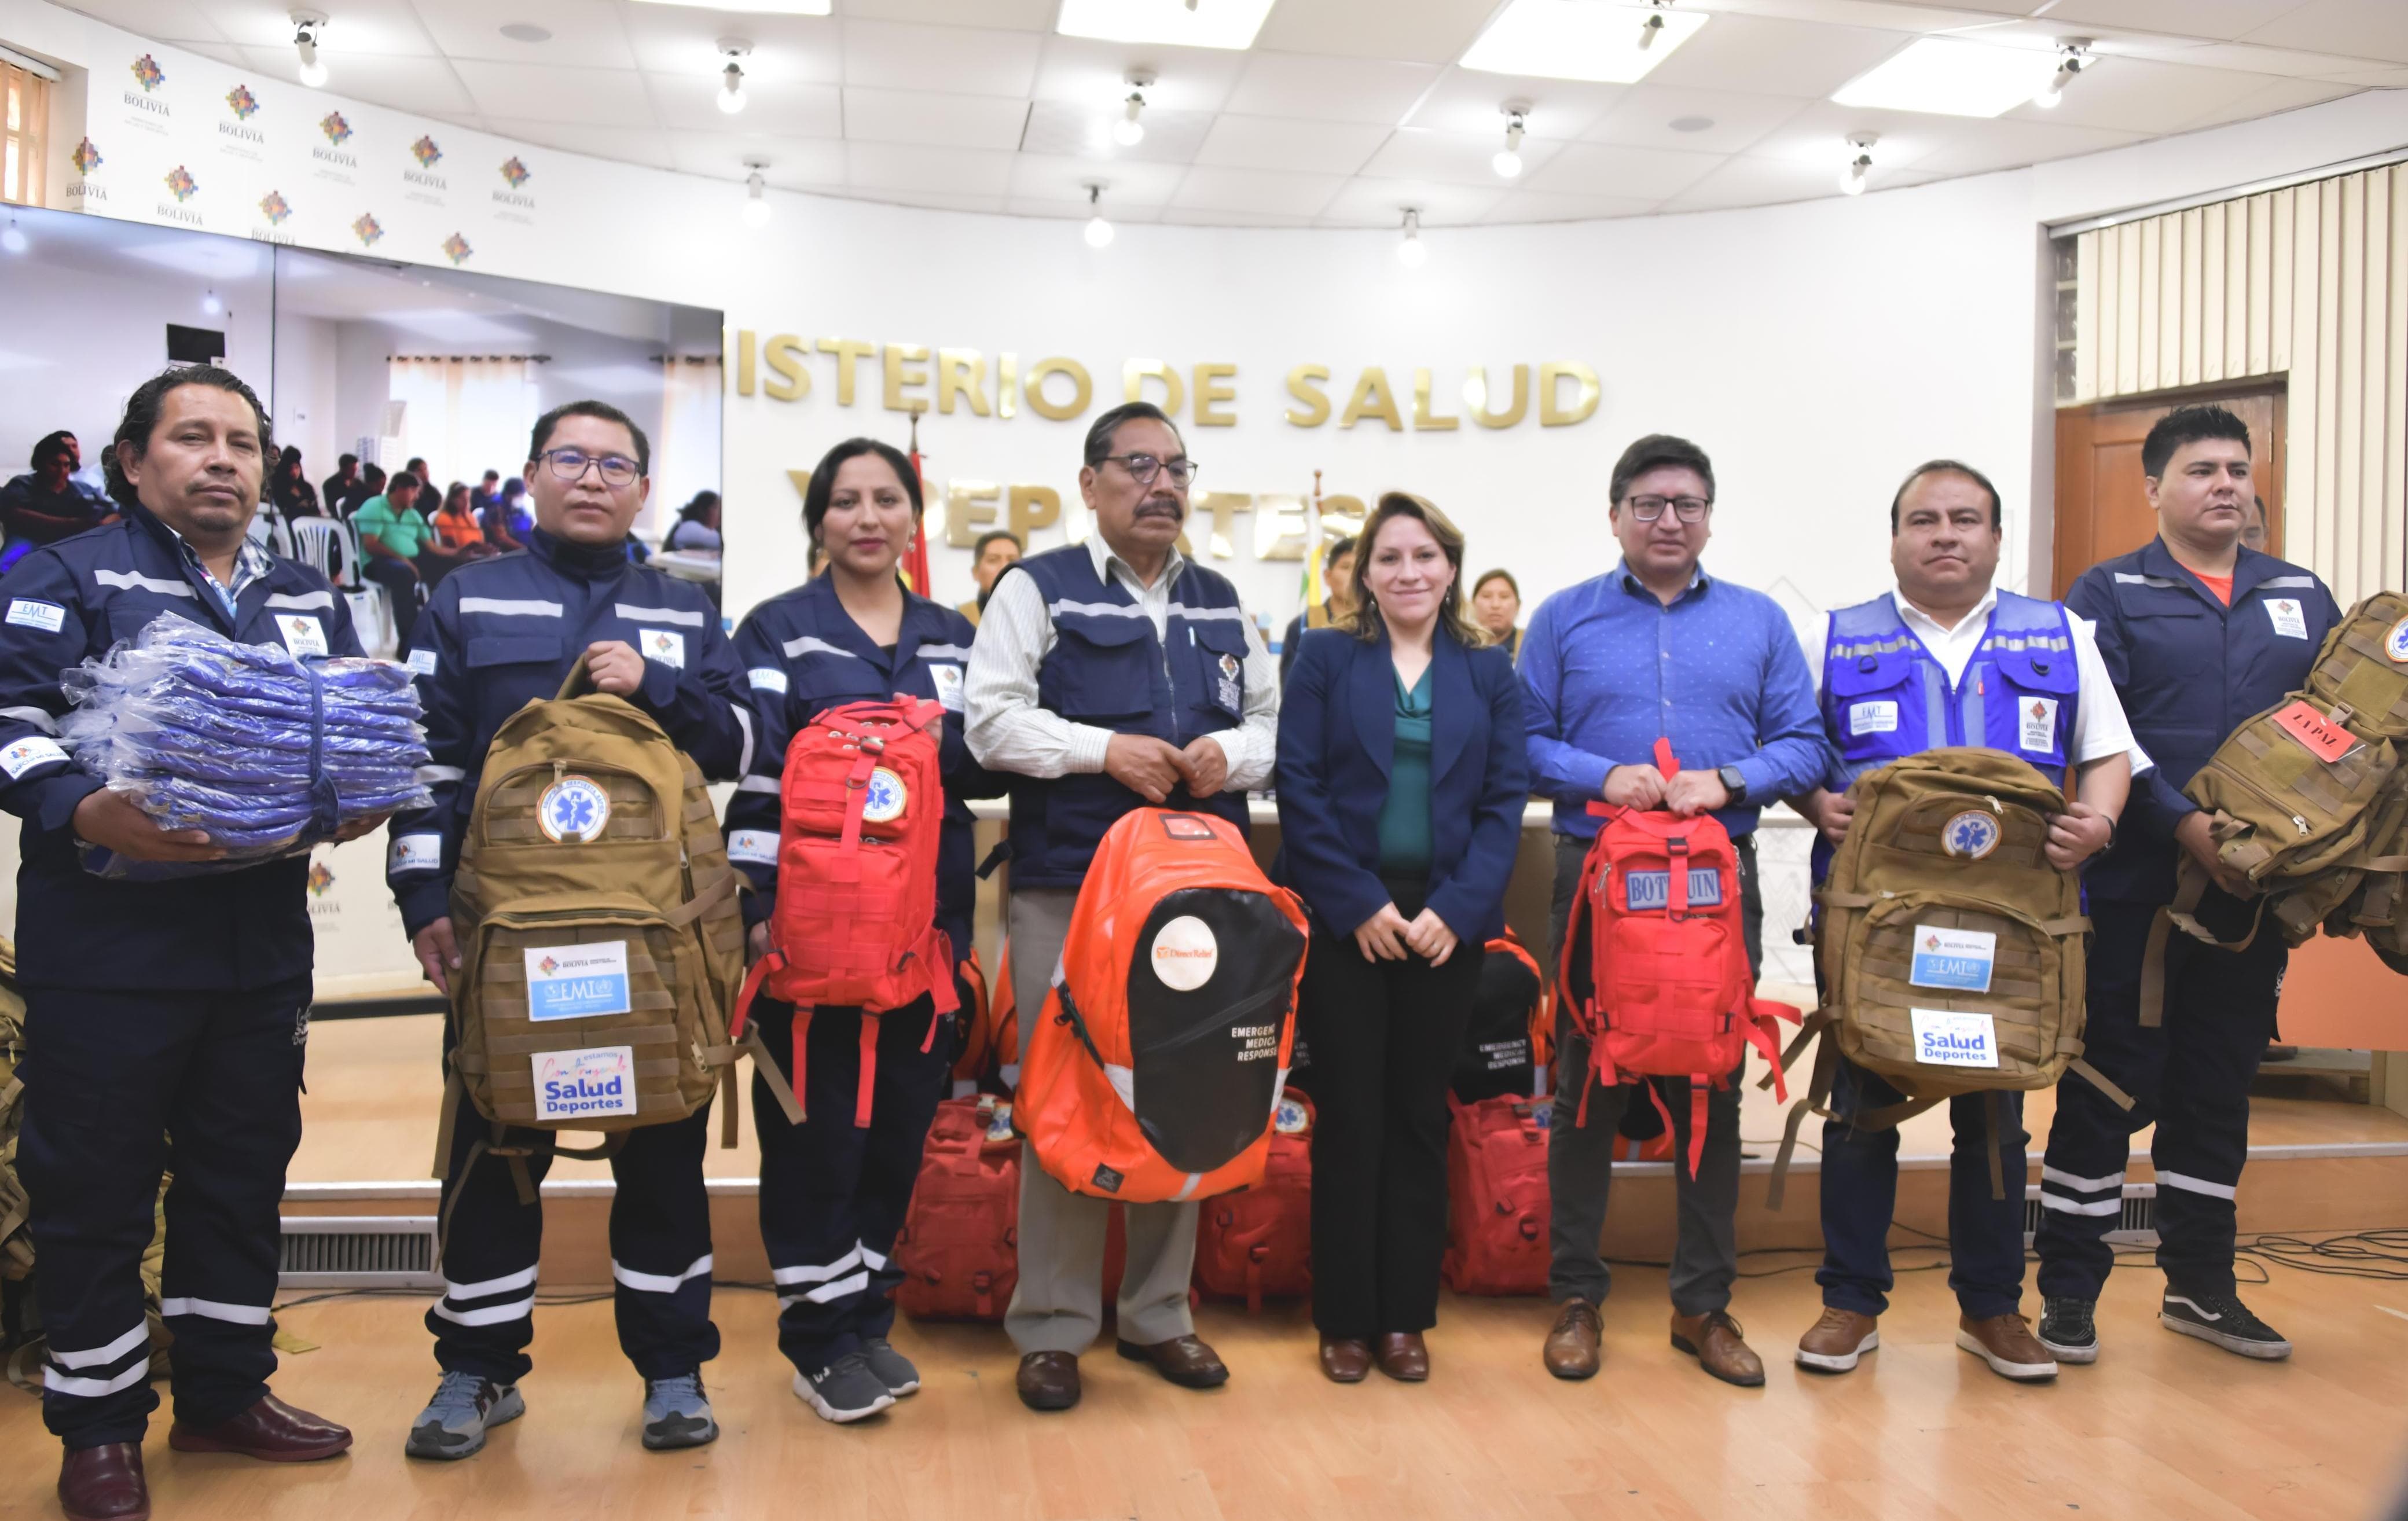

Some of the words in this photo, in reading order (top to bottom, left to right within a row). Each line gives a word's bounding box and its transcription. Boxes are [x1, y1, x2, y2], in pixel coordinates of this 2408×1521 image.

[124, 94, 170, 116] BOLIVIA
[219, 123, 265, 144] BOLIVIA
[313, 148, 357, 169] BOLIVIA
[403, 171, 447, 190] BOLIVIA
[66, 184, 108, 201] BOLIVIA
[492, 192, 535, 208] BOLIVIA
[157, 205, 203, 226] BOLIVIA
[723, 325, 1092, 421] ISTERIO
[1122, 357, 1238, 427] DE
[1285, 360, 1600, 431] SALUD
[23, 603, 48, 618] EMT
[1862, 705, 1881, 720] EMT
[2293, 714, 2311, 729] LA
[2311, 727, 2337, 747] PAZ
[1631, 873, 1716, 901] BOTUIN
[307, 903, 340, 914] LIVIA
[1170, 949, 1192, 957] Direct
[1194, 949, 1213, 957] Relief
[560, 979, 595, 1000] EMT
[1923, 1032, 1985, 1050] Salud
[583, 1051, 618, 1060] estamos
[1237, 1046, 1277, 1061] RESPONSE
[1925, 1048, 1987, 1060] Deportes
[545, 1075, 622, 1100] Salud
[546, 1098, 623, 1114] Deportes
